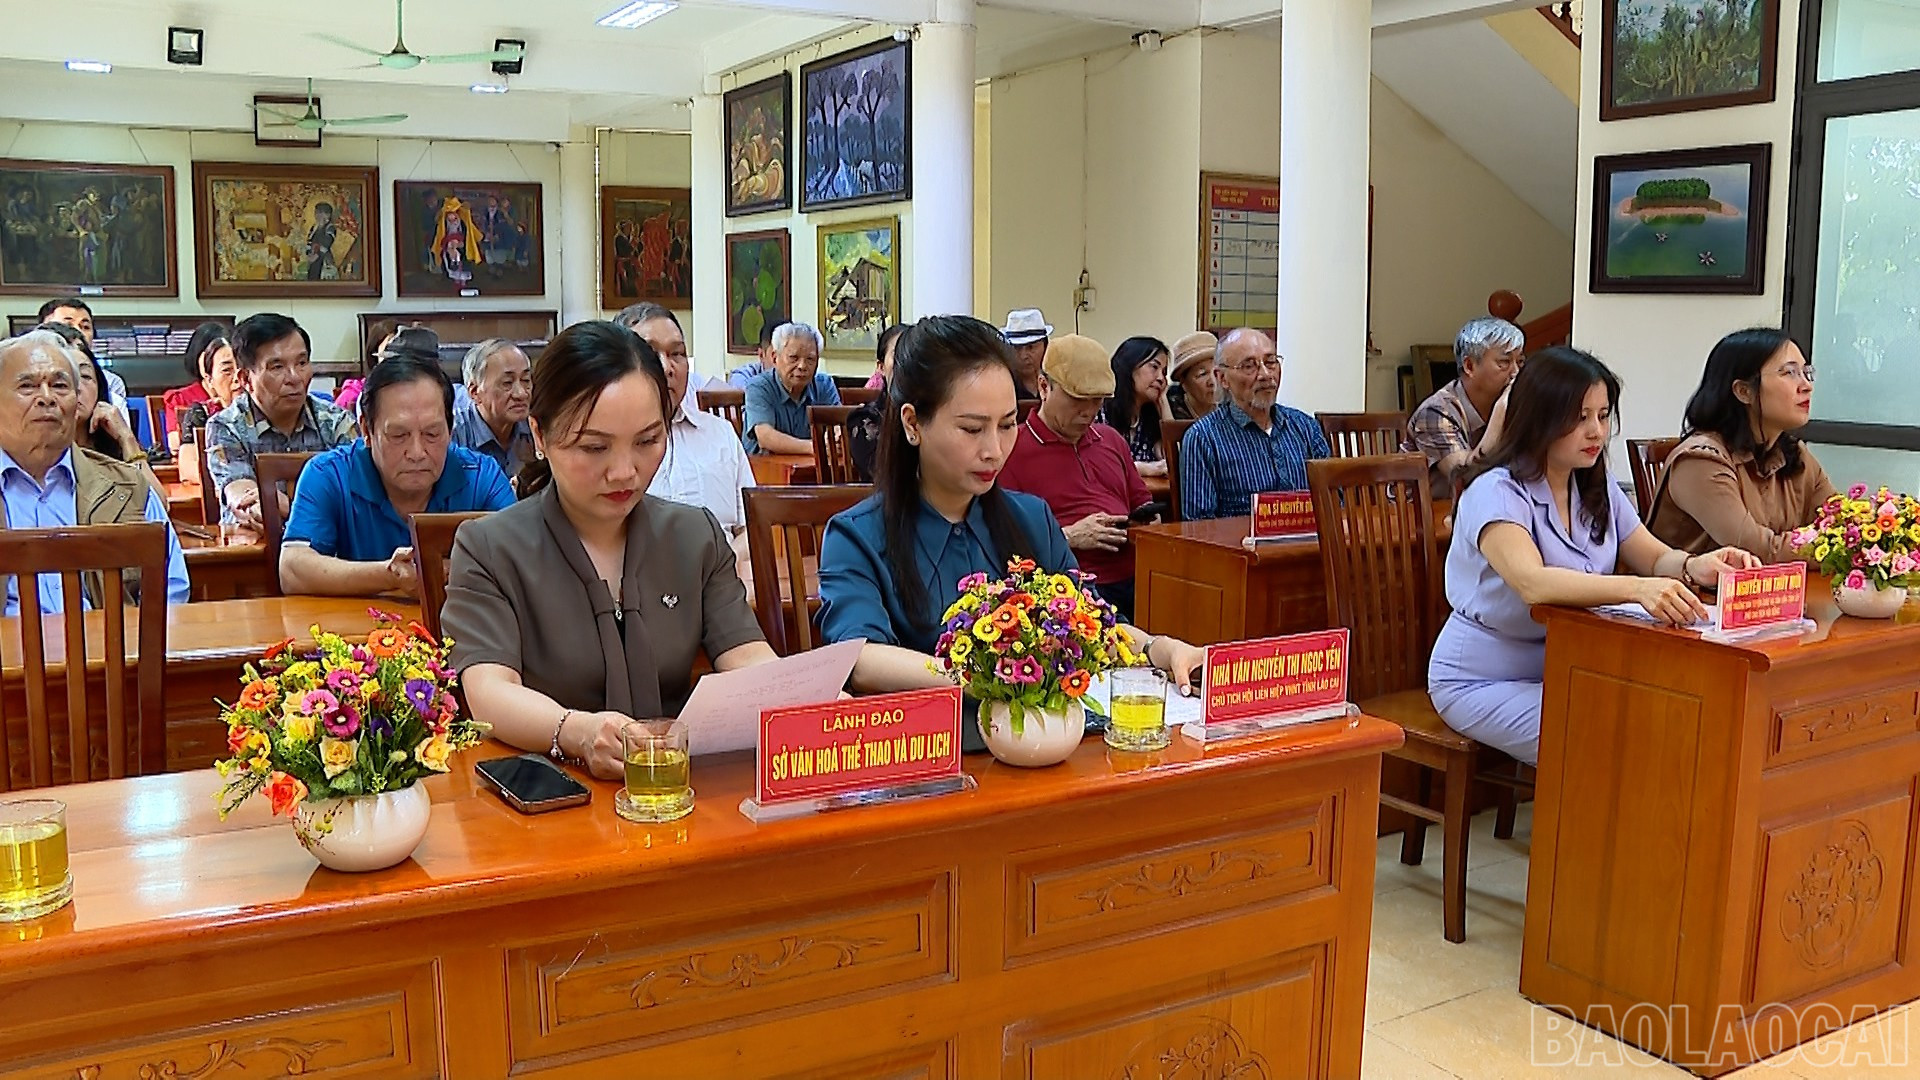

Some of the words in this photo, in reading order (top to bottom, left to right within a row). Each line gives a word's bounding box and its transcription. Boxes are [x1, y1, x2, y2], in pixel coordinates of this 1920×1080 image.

[1212, 658, 1230, 687] NHÀ
[1232, 657, 1250, 684] VĂN
[1251, 648, 1285, 682] NGUYỄN
[1287, 654, 1300, 680] THỊ
[1301, 650, 1324, 678] NGỌC
[1325, 641, 1341, 672] YẾN
[1227, 690, 1241, 708] TỊCH
[1242, 687, 1254, 704] HỘI
[1254, 685, 1269, 700] LIÊN
[1269, 683, 1284, 700] HIỆP
[823, 712, 866, 732] LÃNH
[871, 708, 905, 729] ĐẠO
[772, 745, 788, 781] SỞ
[791, 745, 814, 778] VĂN
[816, 741, 839, 775] HOÁ
[841, 733, 863, 771] THỂ
[864, 739, 891, 767] THAO
[894, 731, 908, 764] VÀ
[910, 735, 925, 761] DU
[927, 731, 951, 764] LỊCH
